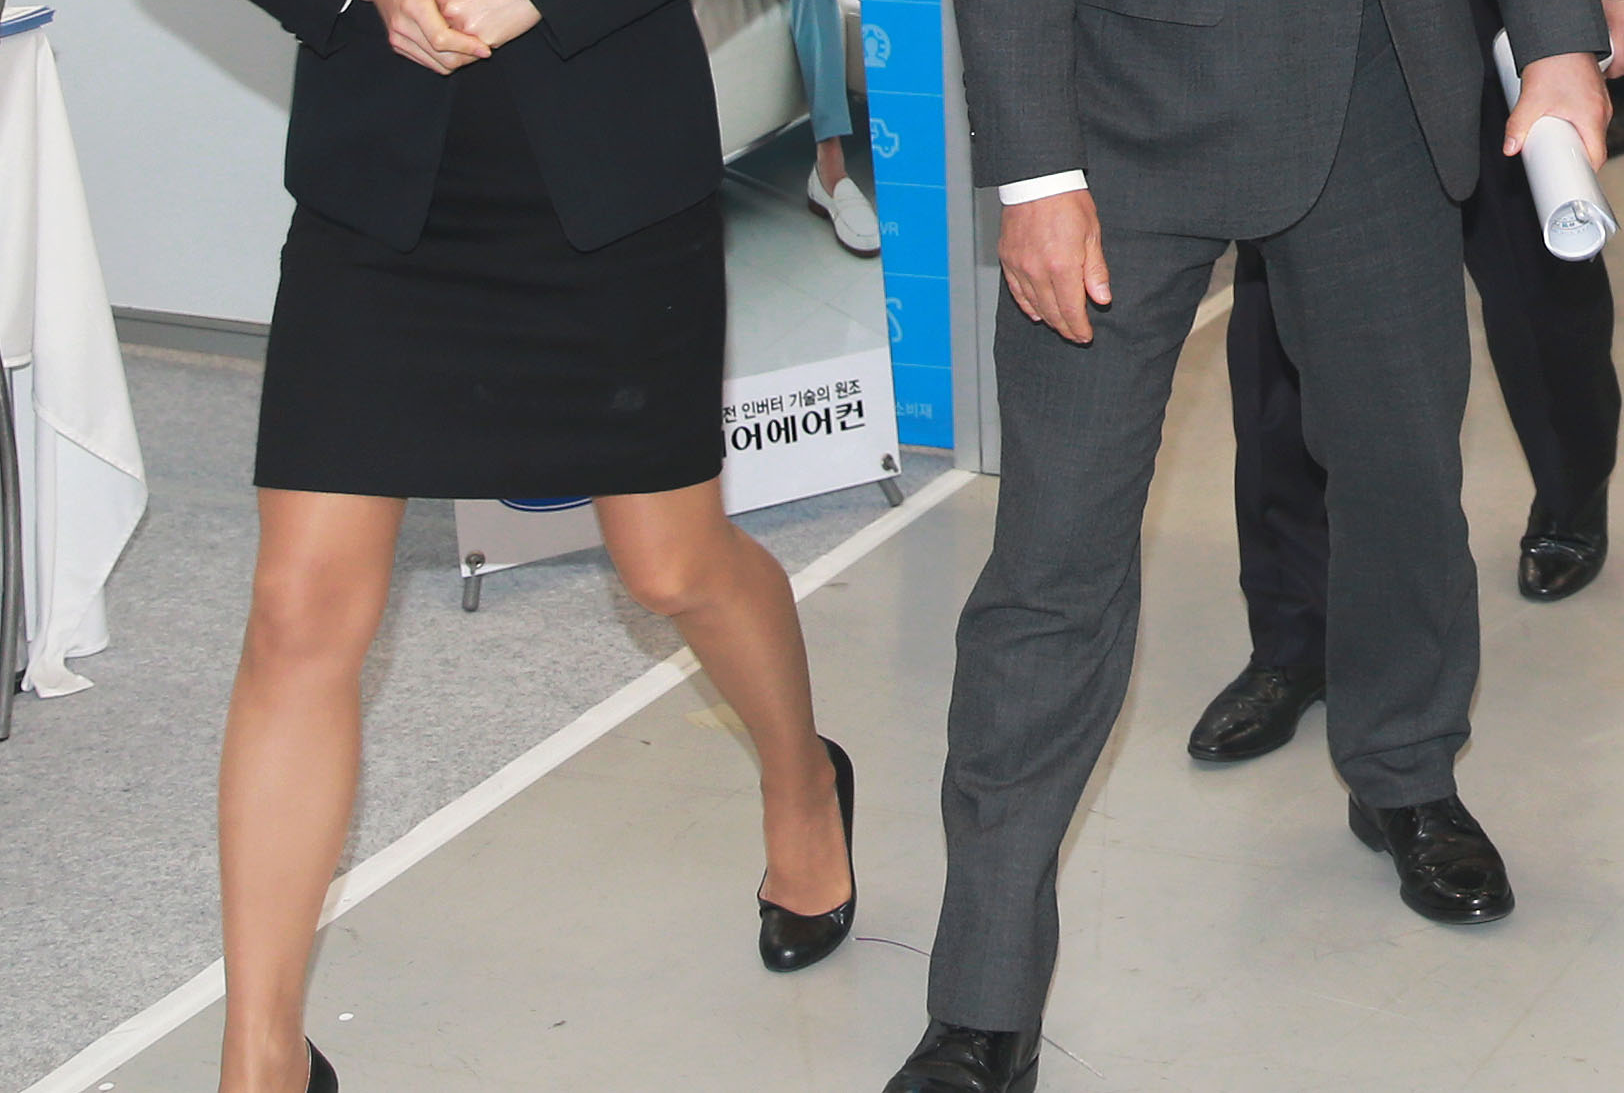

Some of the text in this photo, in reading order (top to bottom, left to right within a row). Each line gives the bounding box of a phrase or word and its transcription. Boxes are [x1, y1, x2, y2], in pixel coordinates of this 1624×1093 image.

[741, 394, 784, 418] 인버터
[789, 385, 831, 408] 기술의
[834, 378, 862, 400] 원조
